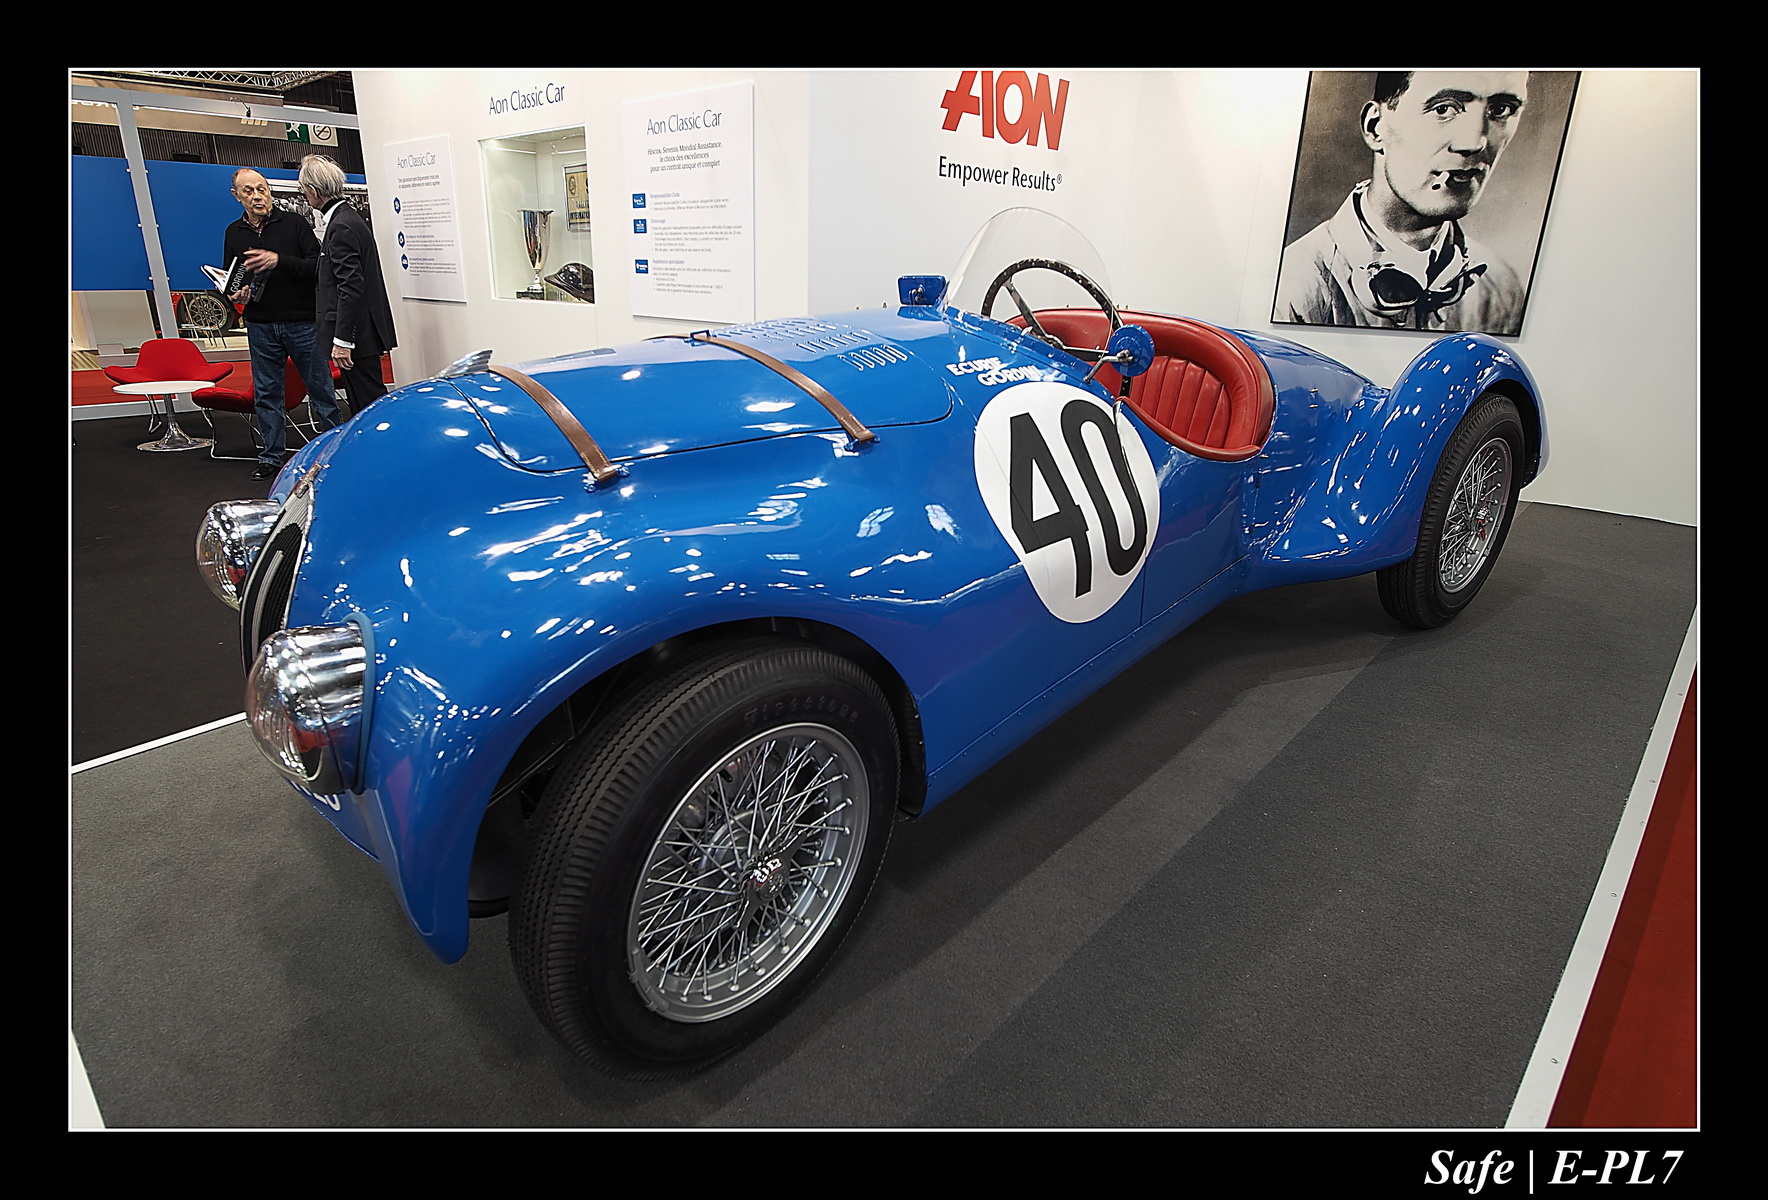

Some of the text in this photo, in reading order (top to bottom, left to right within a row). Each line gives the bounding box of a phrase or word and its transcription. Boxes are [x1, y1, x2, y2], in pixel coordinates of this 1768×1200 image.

[489, 82, 565, 115] Aon Classic Car
[940, 71, 1070, 151] AON
[647, 109, 722, 135] Aon Classic Car
[397, 151, 436, 169] Aon Classic Car
[939, 155, 1009, 187] Empower
[946, 357, 1001, 376] ECURIE
[977, 364, 1042, 386] GORDINI
[1009, 399, 1147, 598] 40
